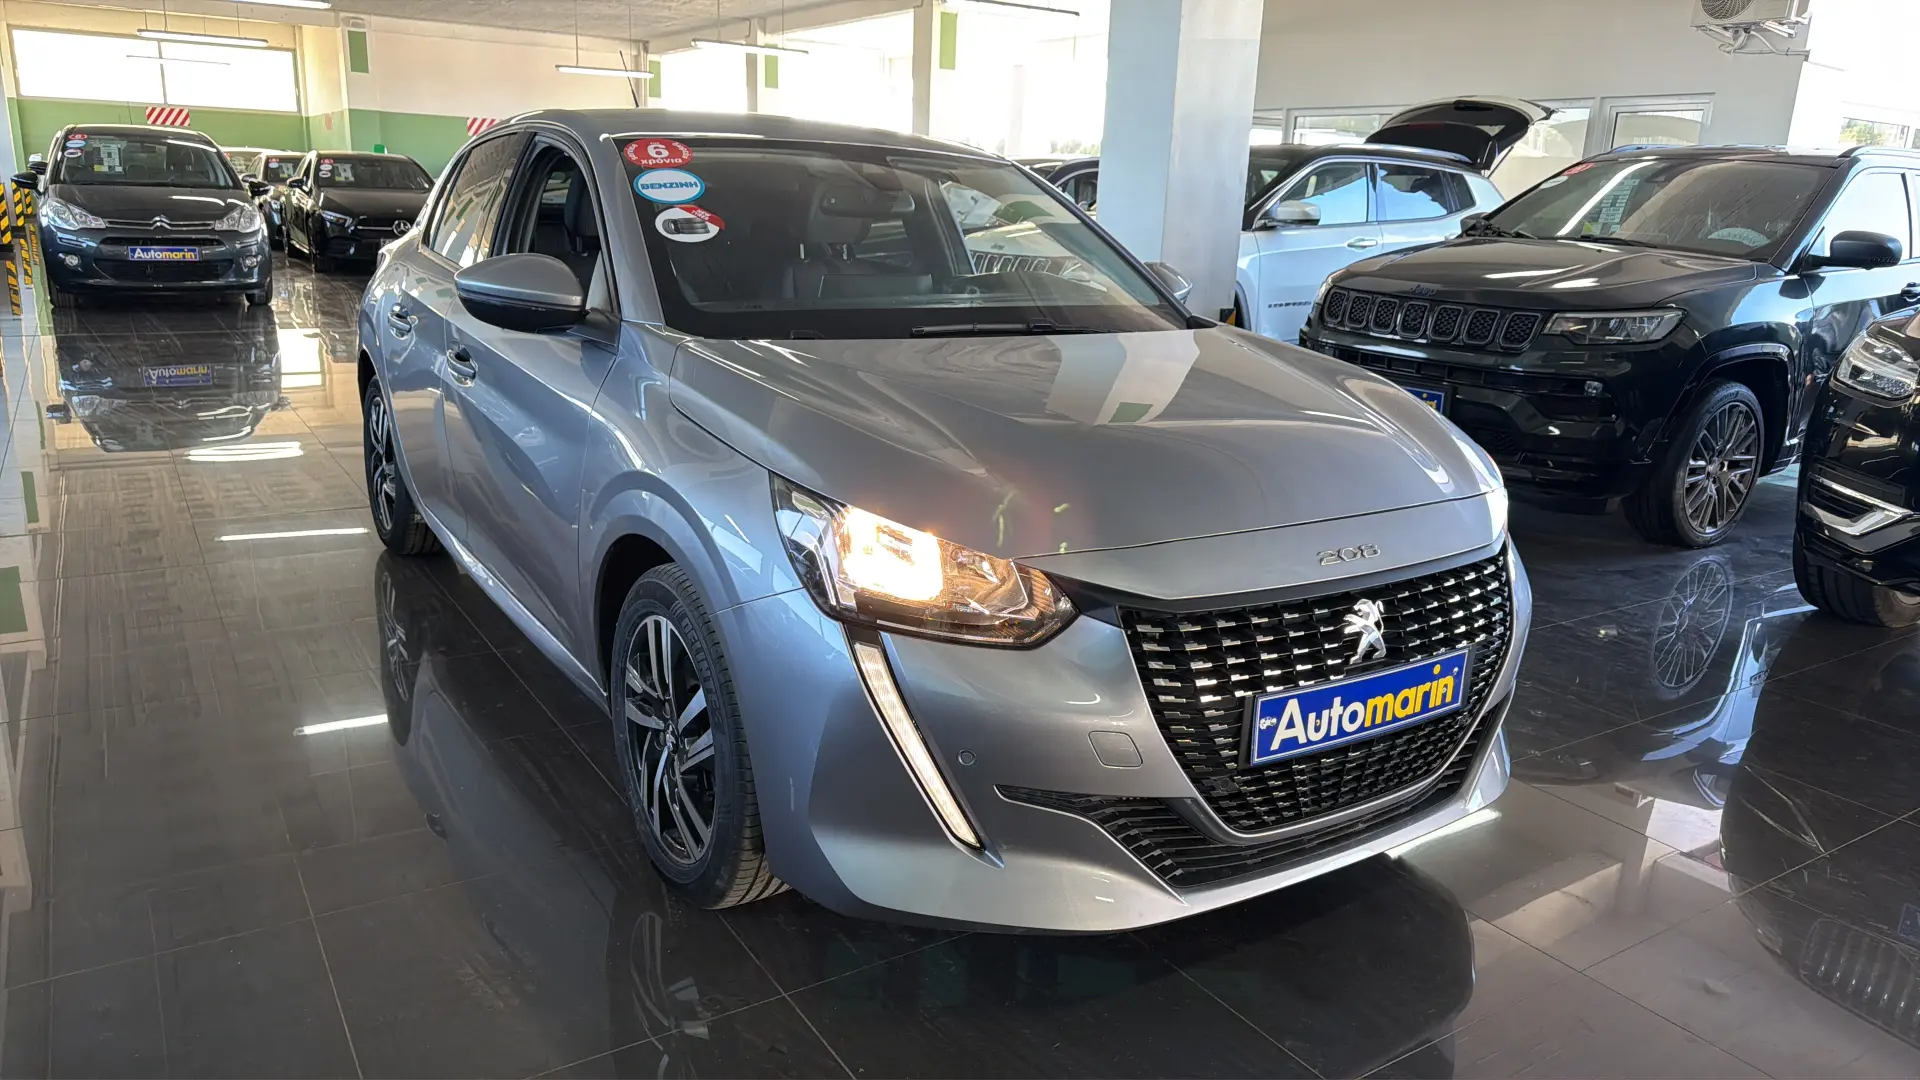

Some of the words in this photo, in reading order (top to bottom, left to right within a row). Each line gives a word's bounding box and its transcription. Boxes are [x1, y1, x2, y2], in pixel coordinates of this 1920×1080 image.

[647, 145, 669, 158] 6
[640, 157, 683, 165] χρόνια
[134, 248, 195, 259] Automarin
[1316, 543, 1380, 566] 208
[1270, 664, 1454, 750] Automarin
